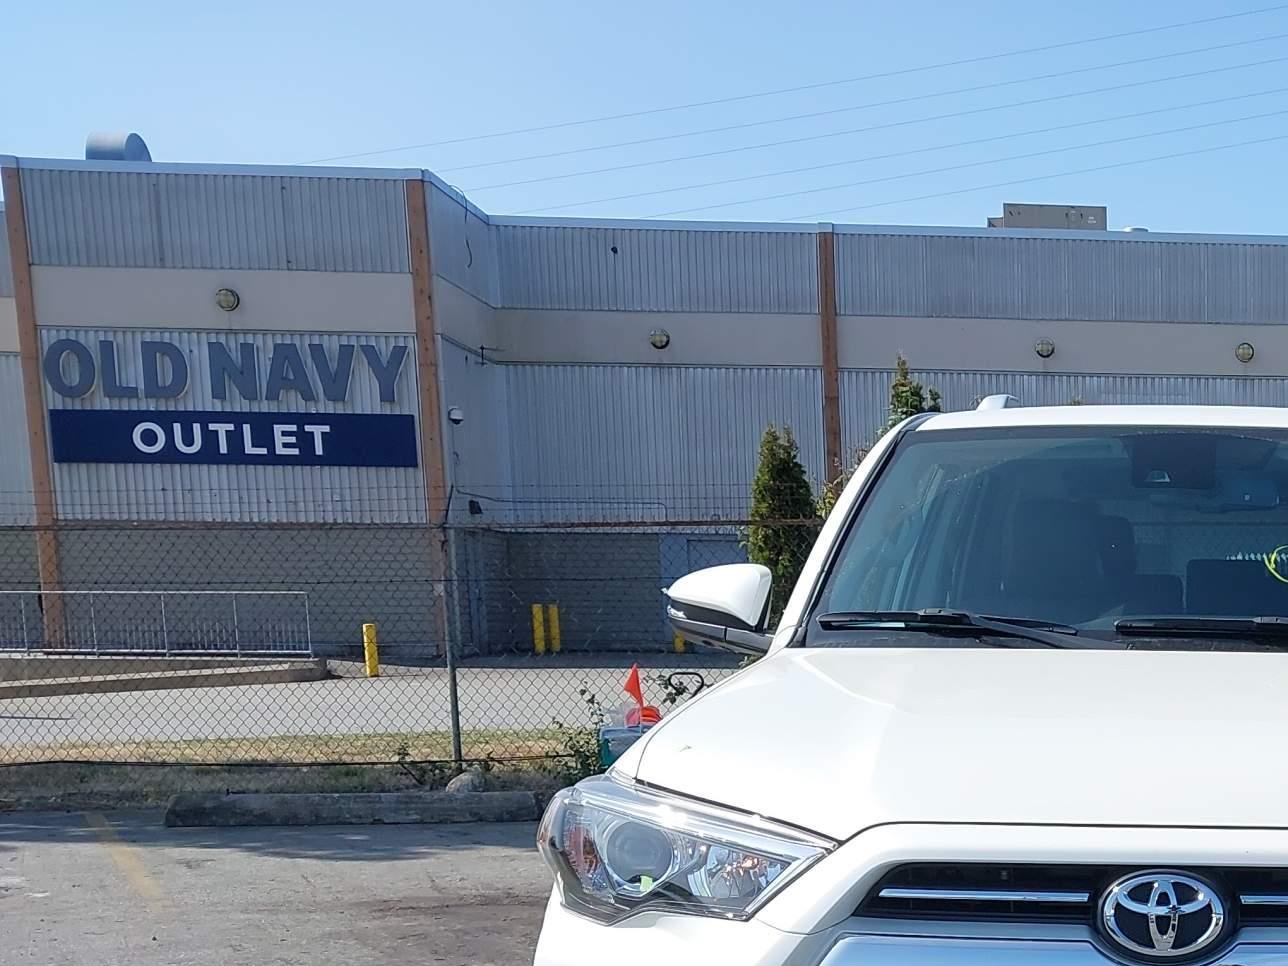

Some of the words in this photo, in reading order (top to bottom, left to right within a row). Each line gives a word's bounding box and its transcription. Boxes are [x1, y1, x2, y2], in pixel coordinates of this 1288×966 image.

[44, 338, 190, 399] OLD
[207, 341, 410, 402] NAVY
[132, 421, 331, 455] OUTLET
